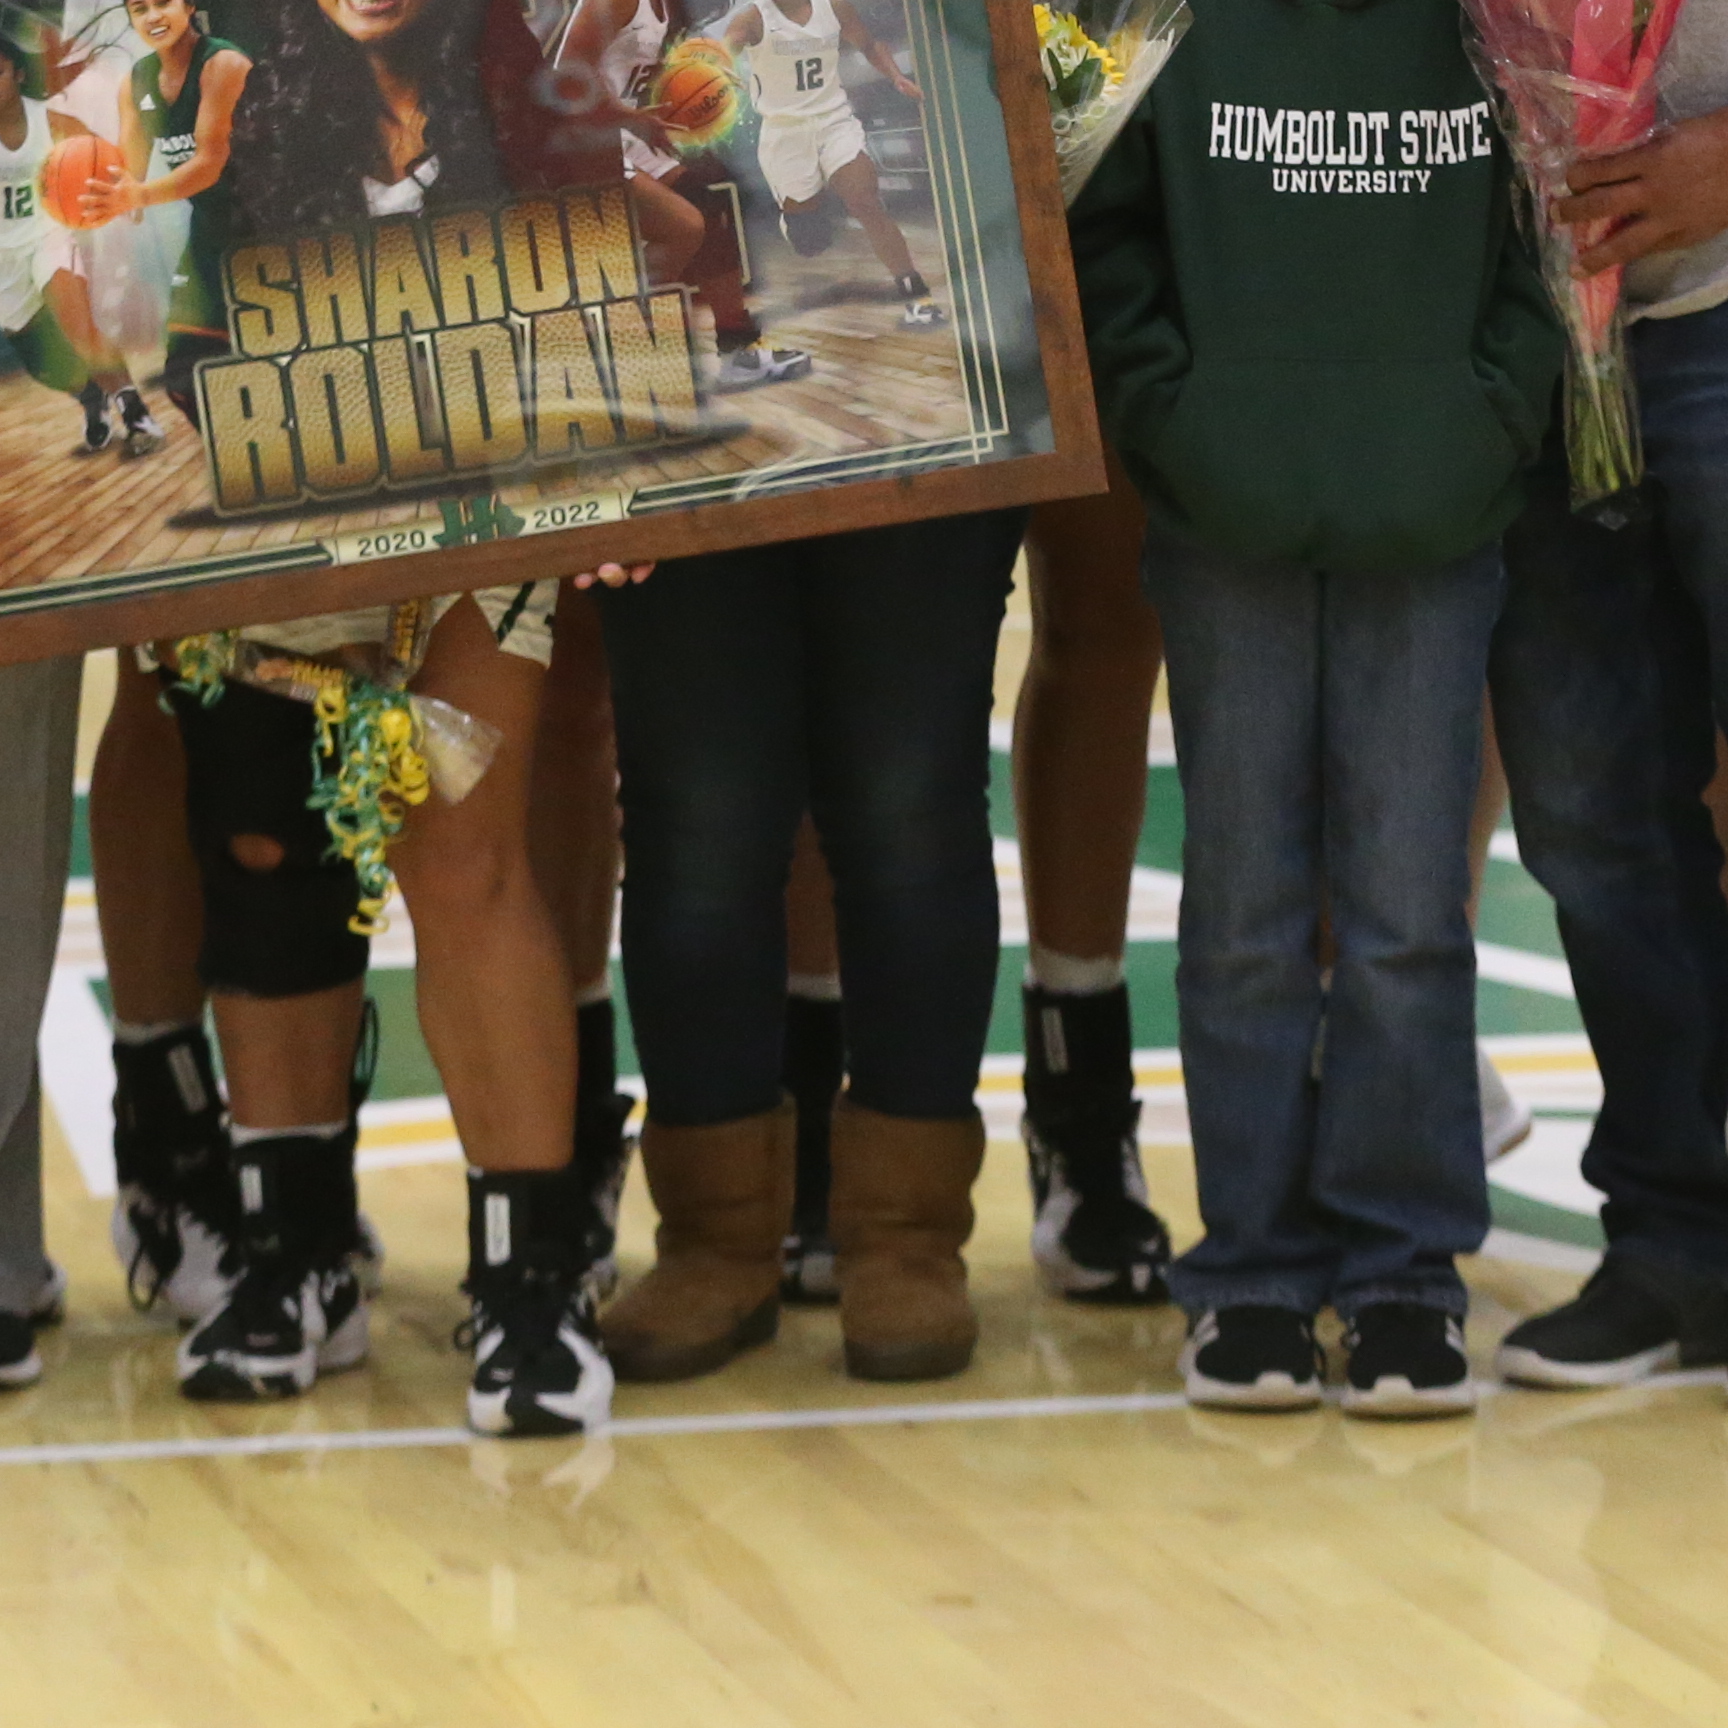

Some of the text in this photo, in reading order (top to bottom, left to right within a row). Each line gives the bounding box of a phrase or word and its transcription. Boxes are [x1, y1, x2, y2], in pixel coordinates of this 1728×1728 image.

[795, 57, 824, 91] 12
[1209, 101, 1492, 165] HUMBOLDT STATE
[3, 185, 34, 219] 12
[1272, 168, 1432, 193] UNIVERSITY
[229, 183, 640, 358] SHARON
[202, 290, 702, 510] ROLDAN
[358, 530, 426, 558] 2020
[534, 501, 602, 529] 2022
